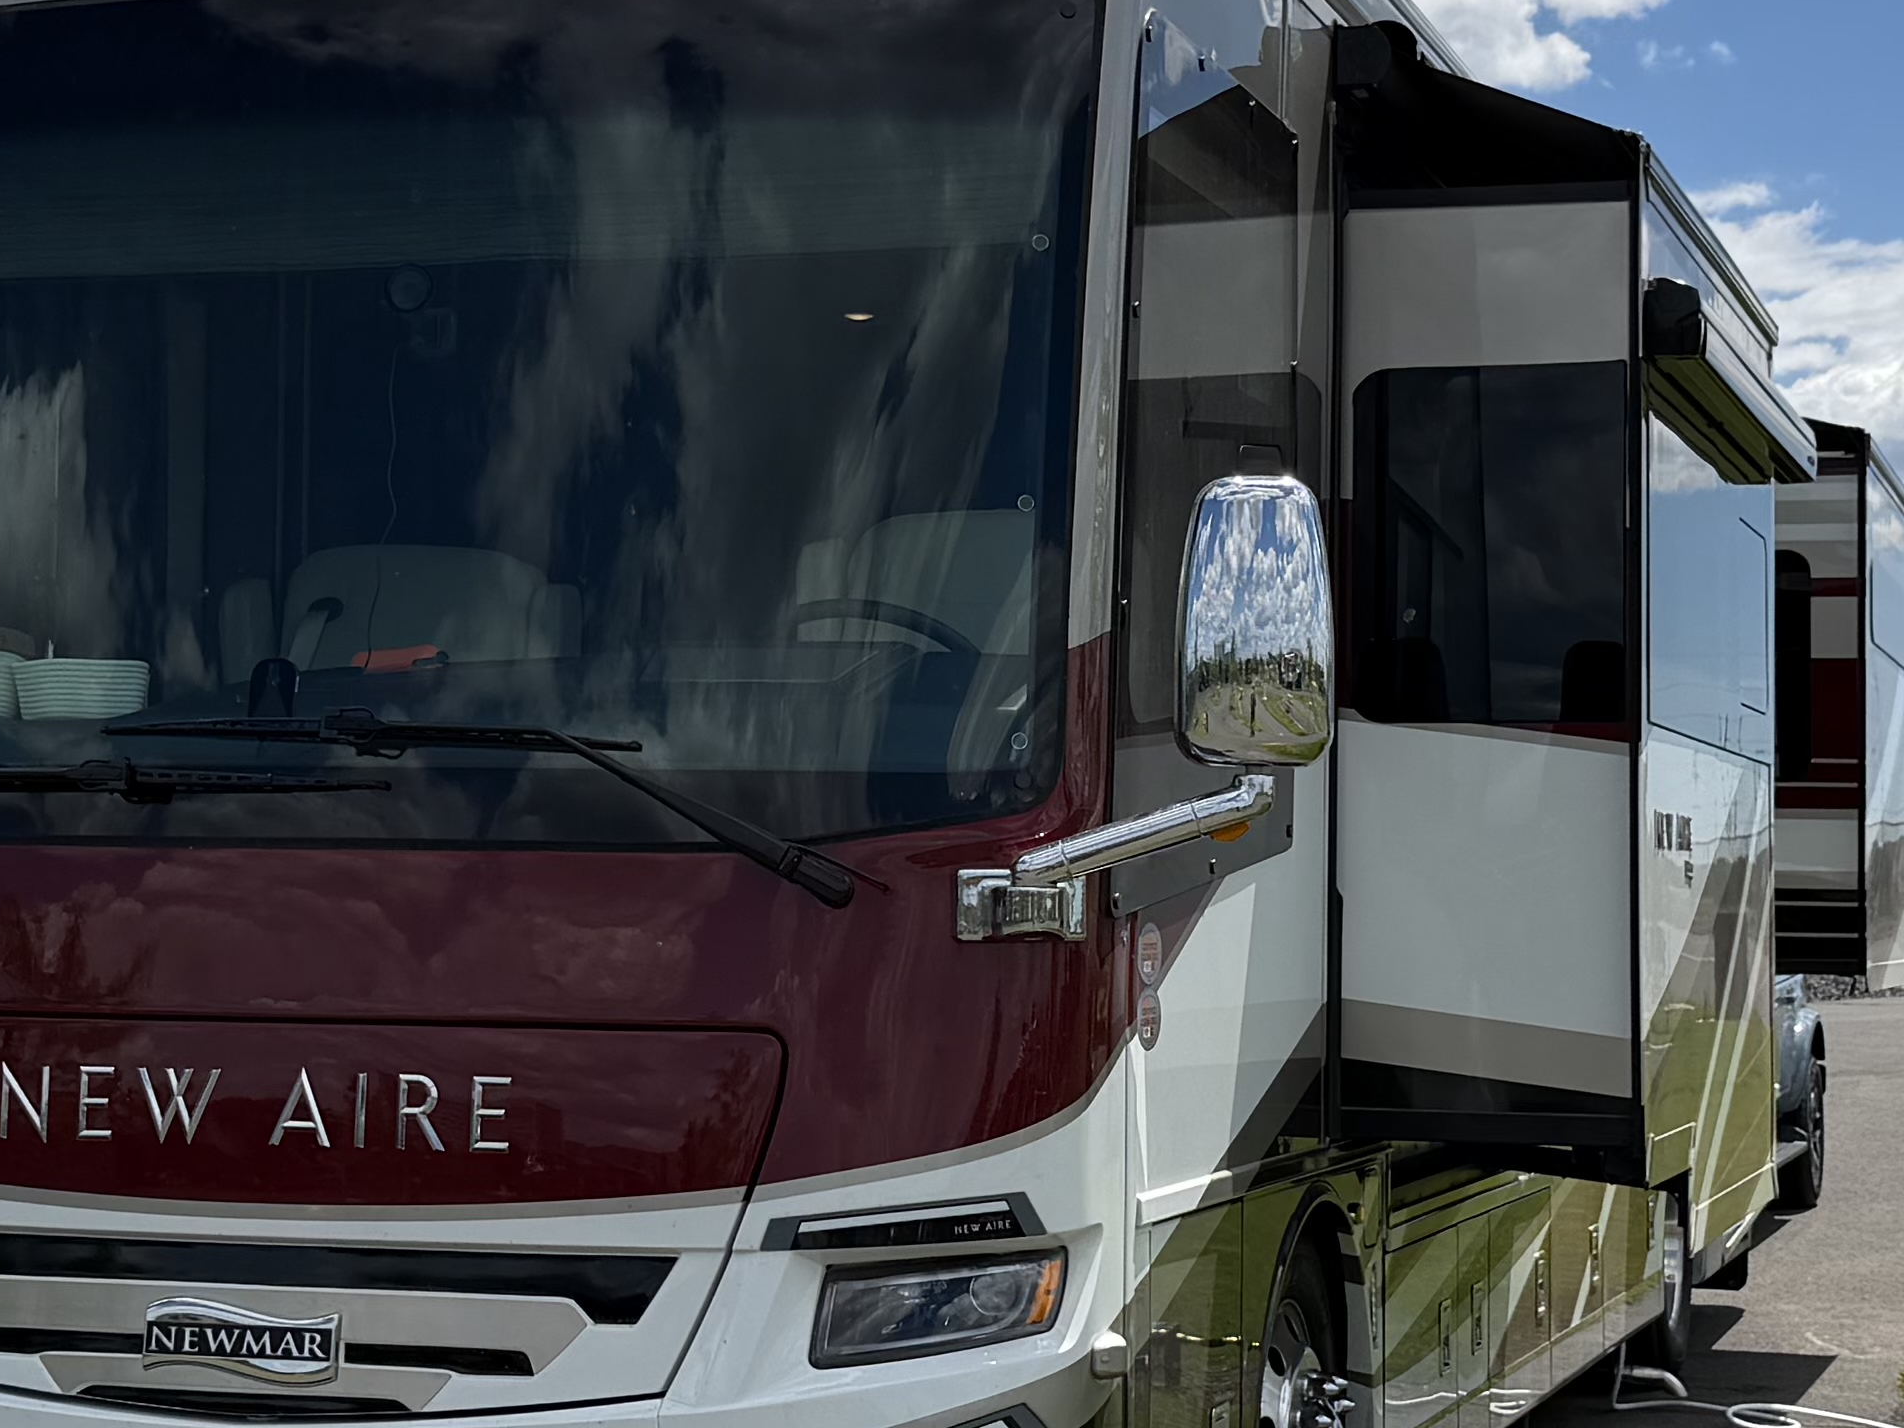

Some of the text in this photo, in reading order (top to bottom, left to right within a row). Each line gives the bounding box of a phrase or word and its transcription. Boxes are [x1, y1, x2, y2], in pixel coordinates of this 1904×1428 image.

[268, 1066, 513, 1154] AIRE
[985, 1219, 1012, 1231] AIRE
[149, 1326, 327, 1357] NEWMAR
